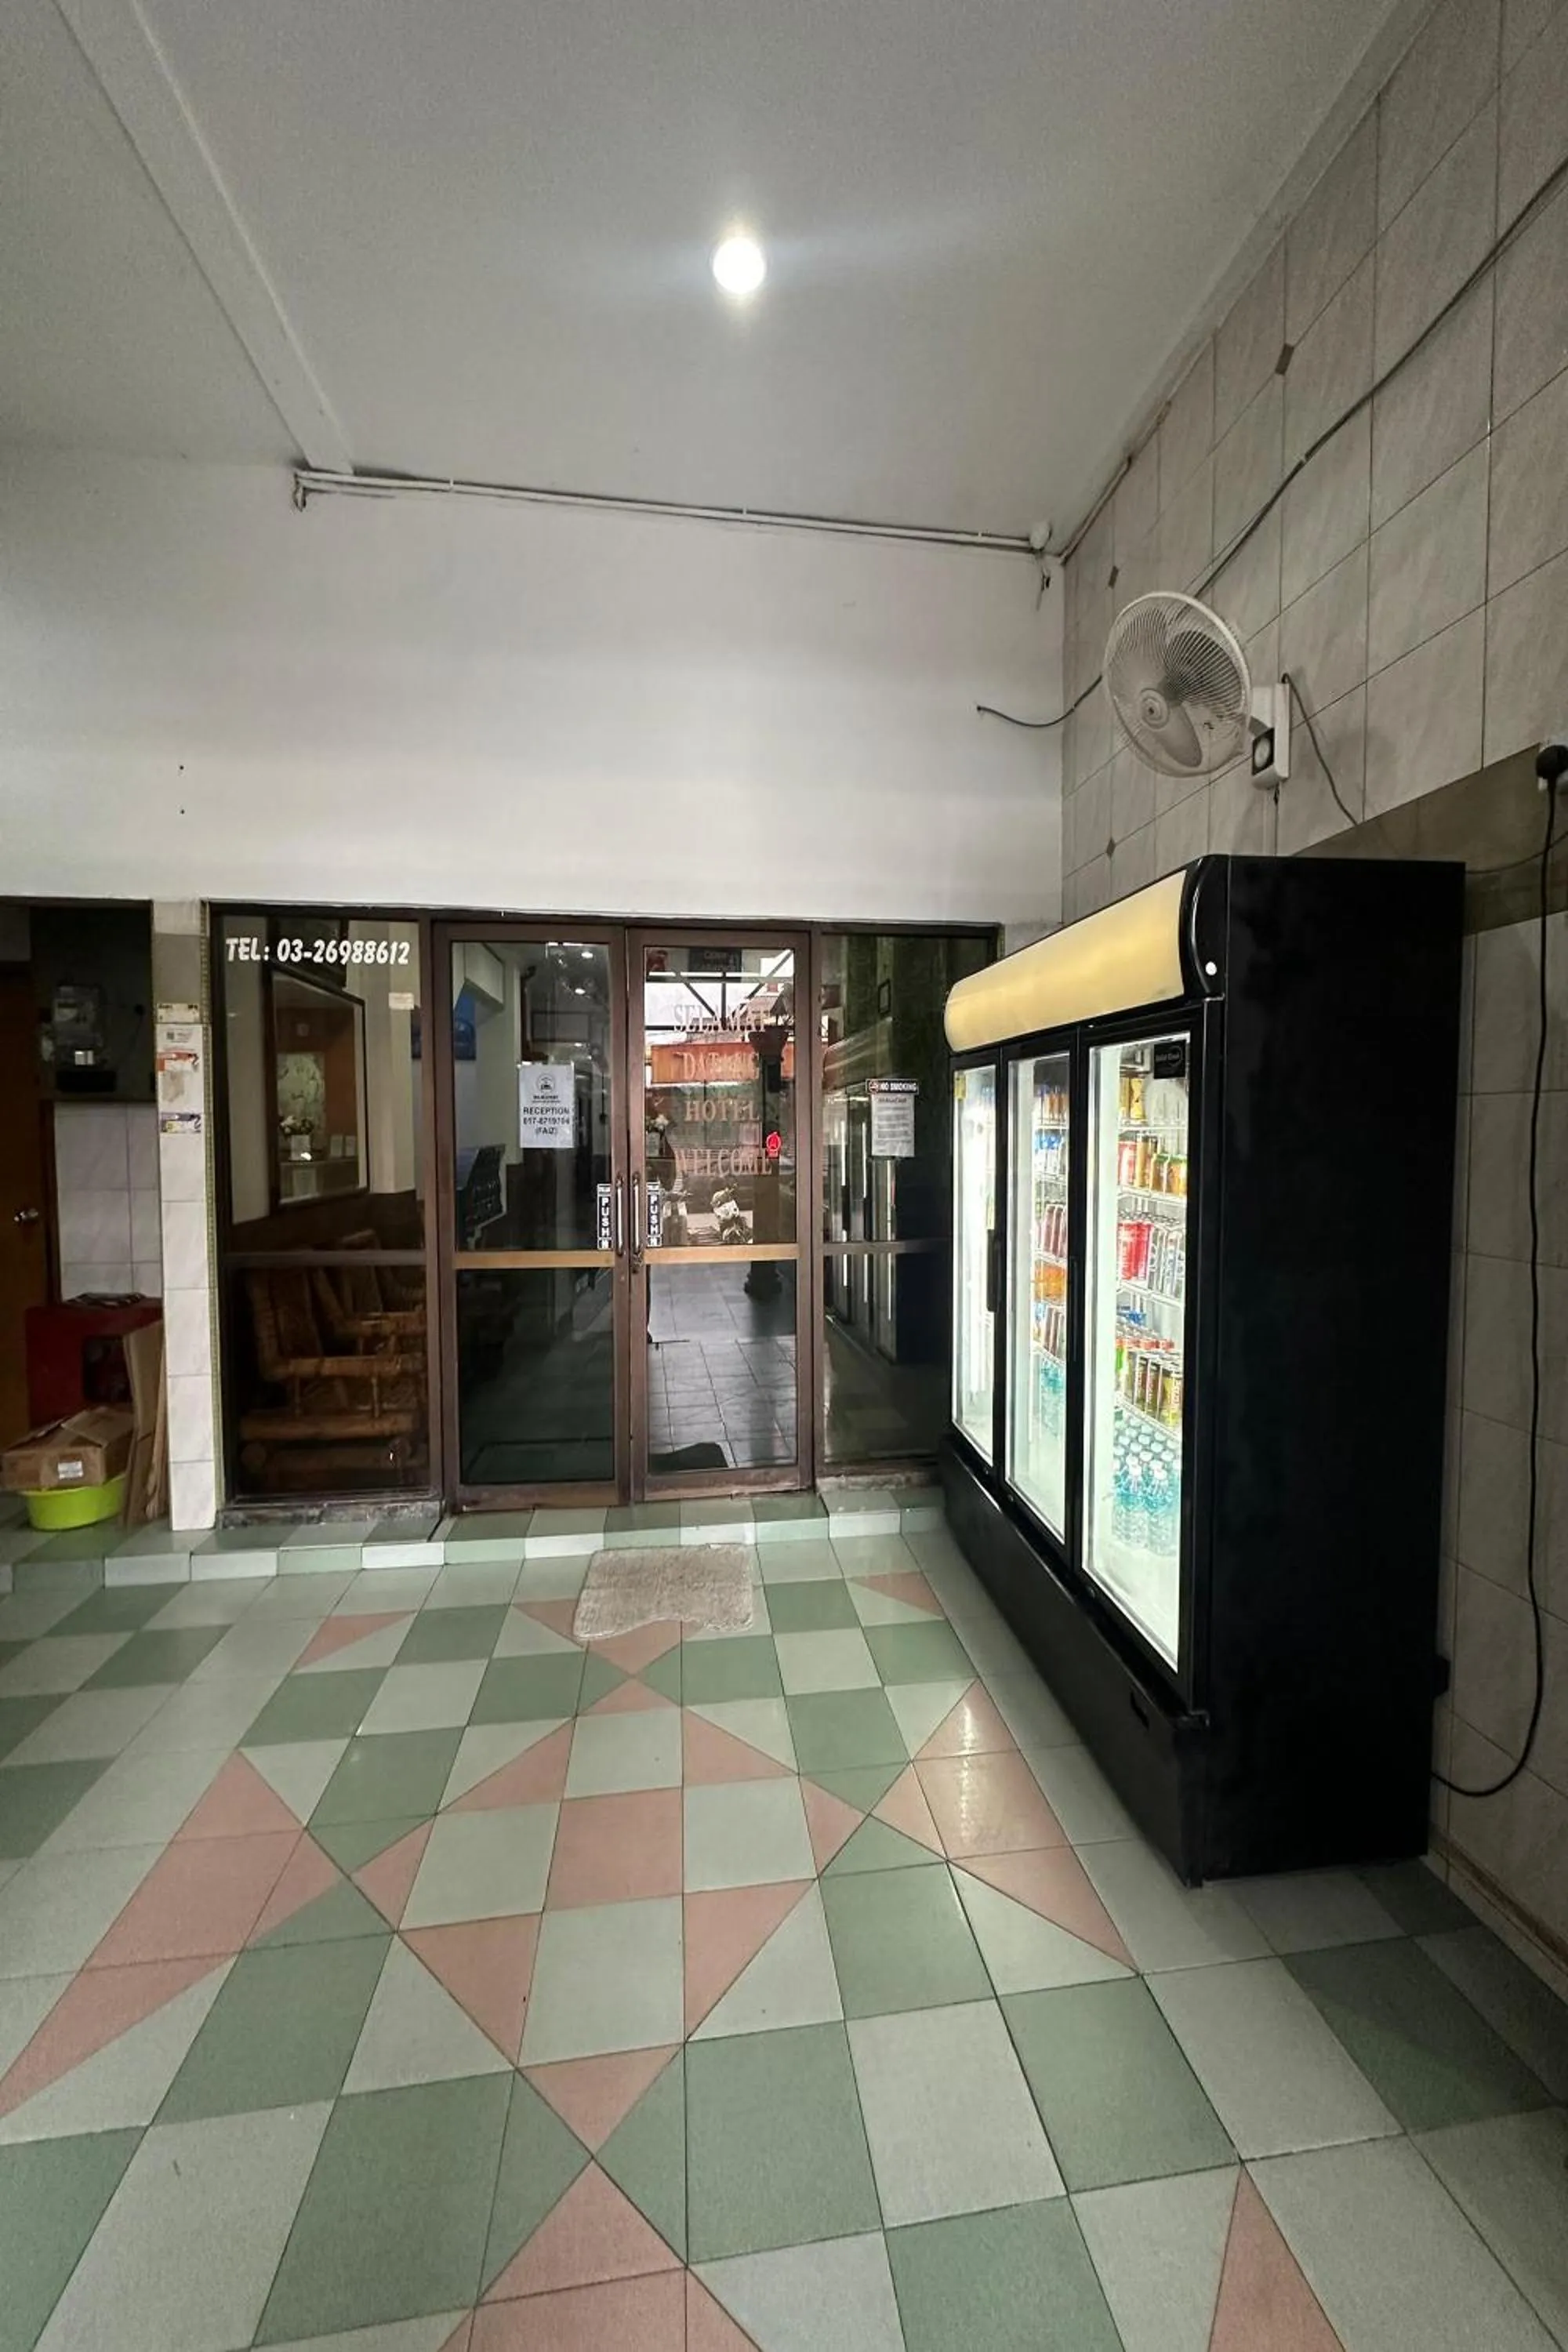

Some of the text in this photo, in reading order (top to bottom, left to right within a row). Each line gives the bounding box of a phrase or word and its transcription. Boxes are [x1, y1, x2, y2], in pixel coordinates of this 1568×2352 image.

[226, 938, 411, 964] TEL: 03-26988612
[880, 1083, 916, 1091] NO SMOKING
[684, 1099, 760, 1121] HOTEL
[674, 1148, 771, 1175] WELCOME
